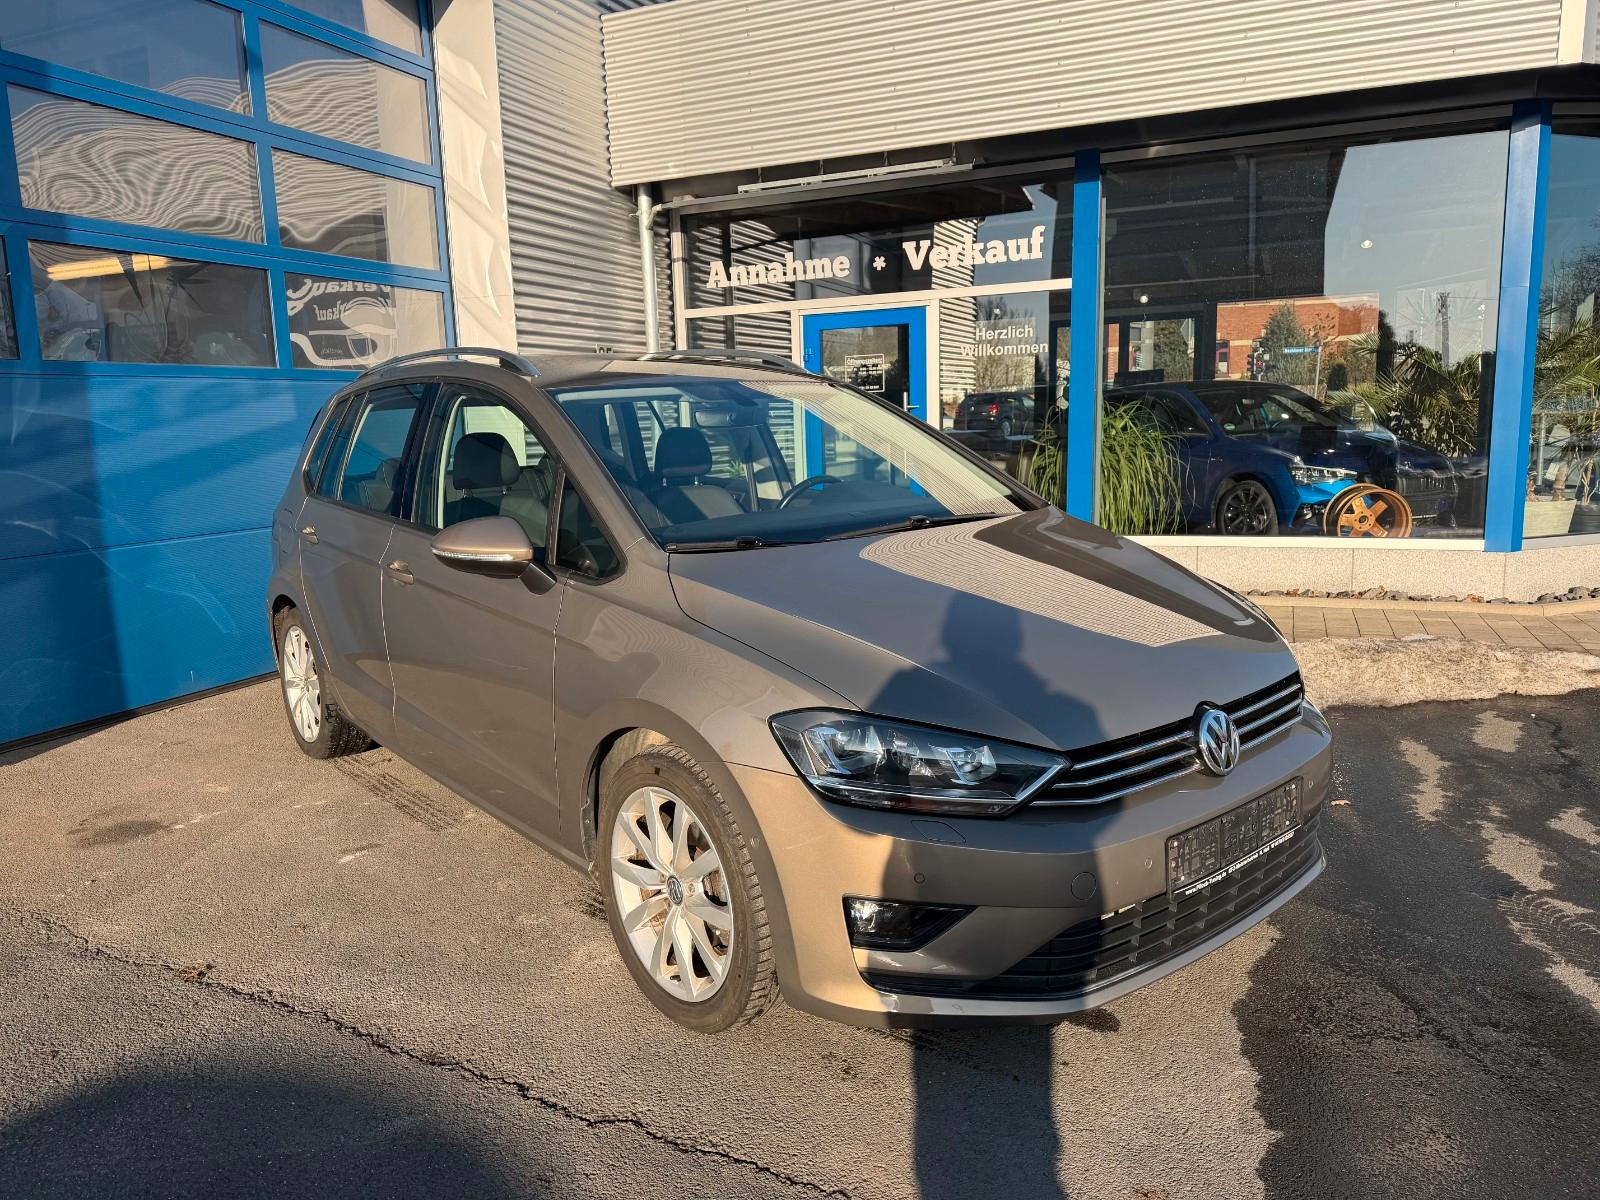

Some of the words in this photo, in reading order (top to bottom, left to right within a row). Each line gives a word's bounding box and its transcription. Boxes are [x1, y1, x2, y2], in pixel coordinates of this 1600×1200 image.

[706, 251, 851, 288] Annahme
[902, 225, 1046, 271] Verkauf
[975, 325, 1034, 341] Herzlich
[961, 342, 1048, 358] Willkommen
